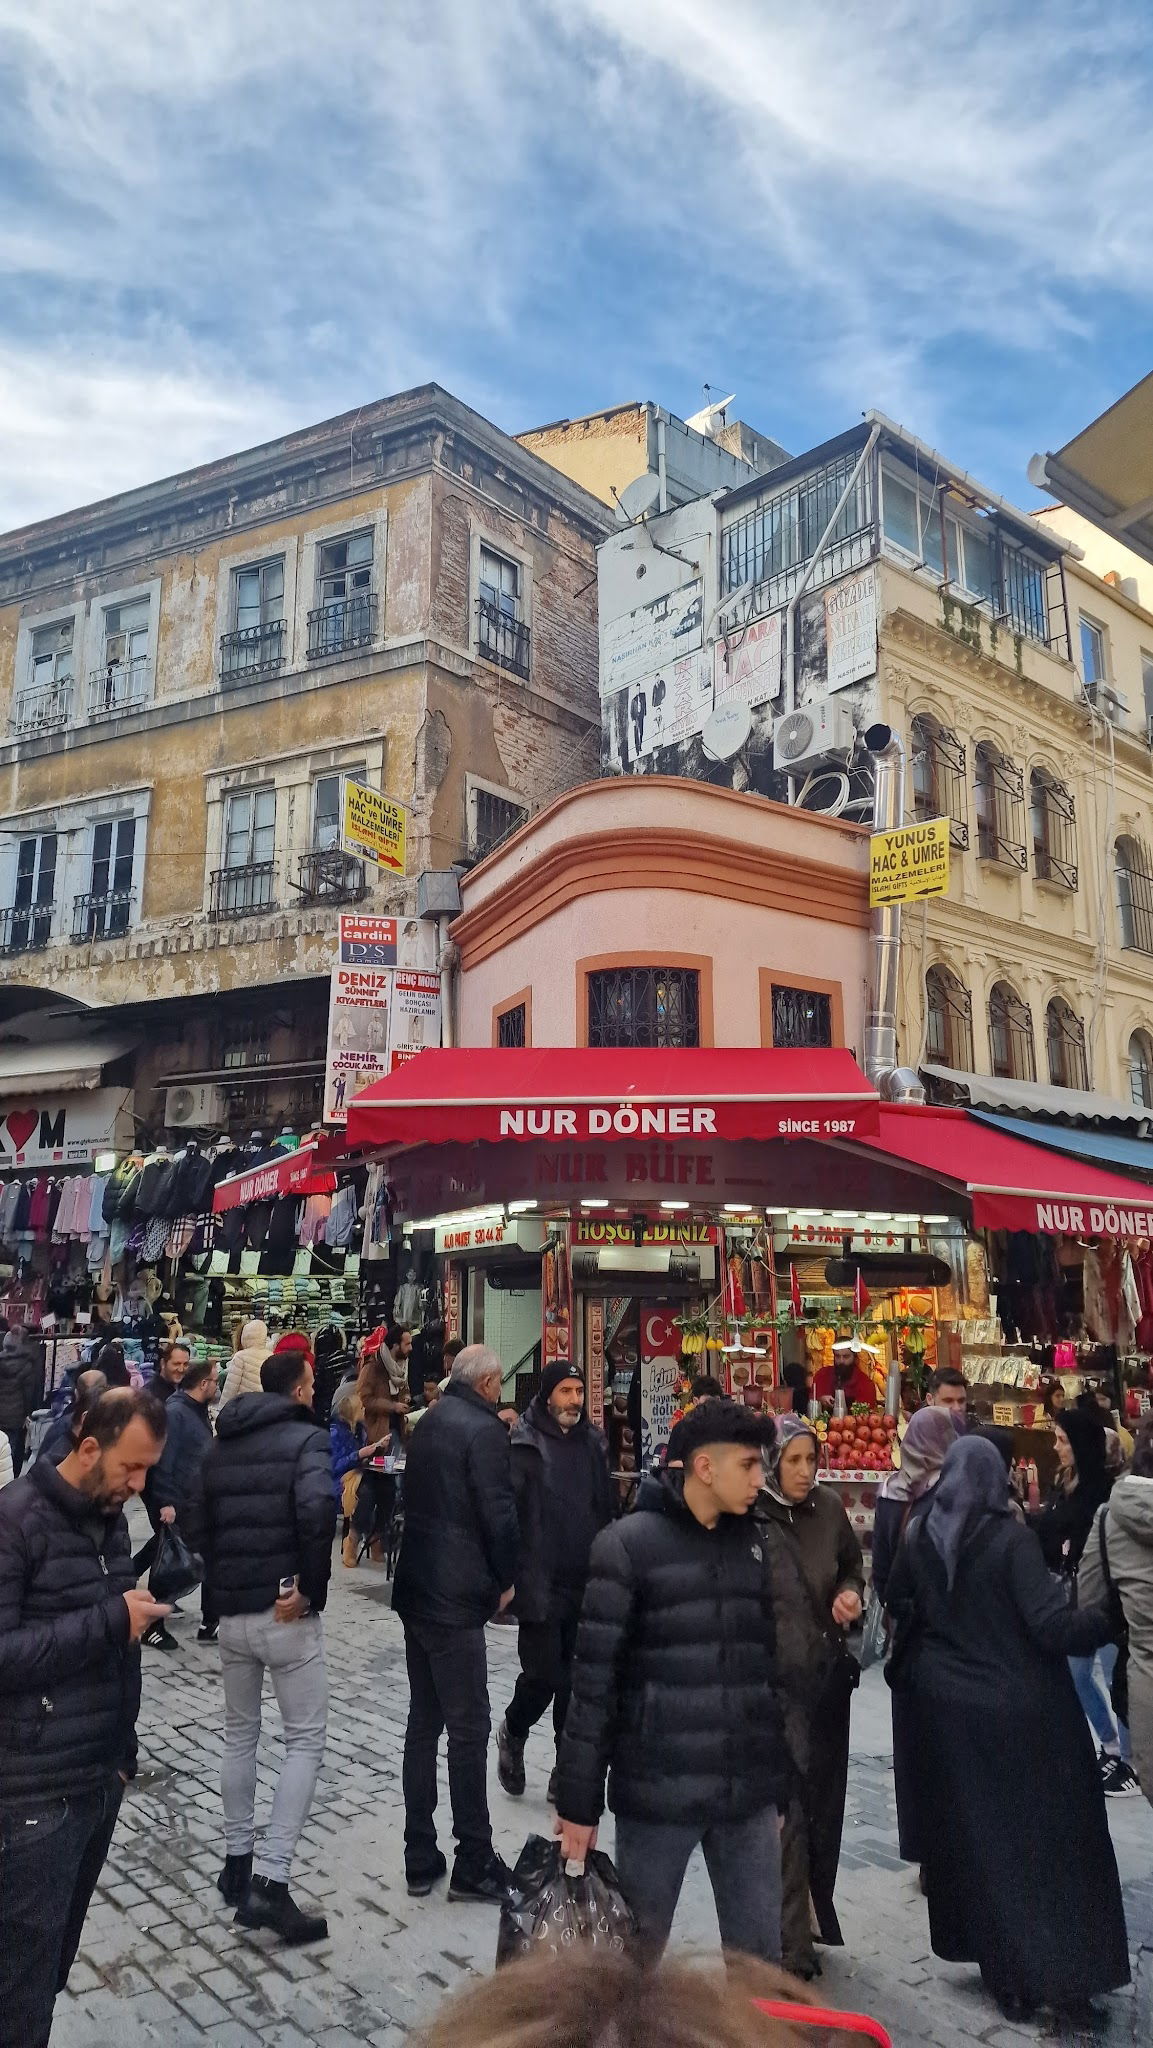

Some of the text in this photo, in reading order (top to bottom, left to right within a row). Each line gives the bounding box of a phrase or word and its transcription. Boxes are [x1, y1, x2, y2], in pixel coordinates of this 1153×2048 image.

[356, 788, 398, 818] YUNUS
[348, 796, 403, 833] HAC ve UMRE
[350, 811, 400, 842] MALZEMELERİ
[885, 827, 936, 851] YUNUS
[872, 841, 945, 873] HAC & UMRE
[344, 917, 391, 928] pierre
[343, 931, 392, 941] cardin
[338, 972, 387, 988] DENİZ
[396, 972, 417, 988] GENÇ
[345, 985, 379, 997] SÜNNET
[417, 992, 438, 1000] DAMAT
[332, 1061, 384, 1071] ÇOCUK ABİYE
[339, 1052, 377, 1062] NEHİR
[500, 1103, 717, 1134] NUR DÖNER
[778, 1117, 856, 1133] SİNCE 1987
[536, 1144, 715, 1185] NUR BÜFE
[240, 1180, 254, 1201] NUR
[254, 1169, 279, 1198] DÖNER
[1036, 1203, 1086, 1232] NUR
